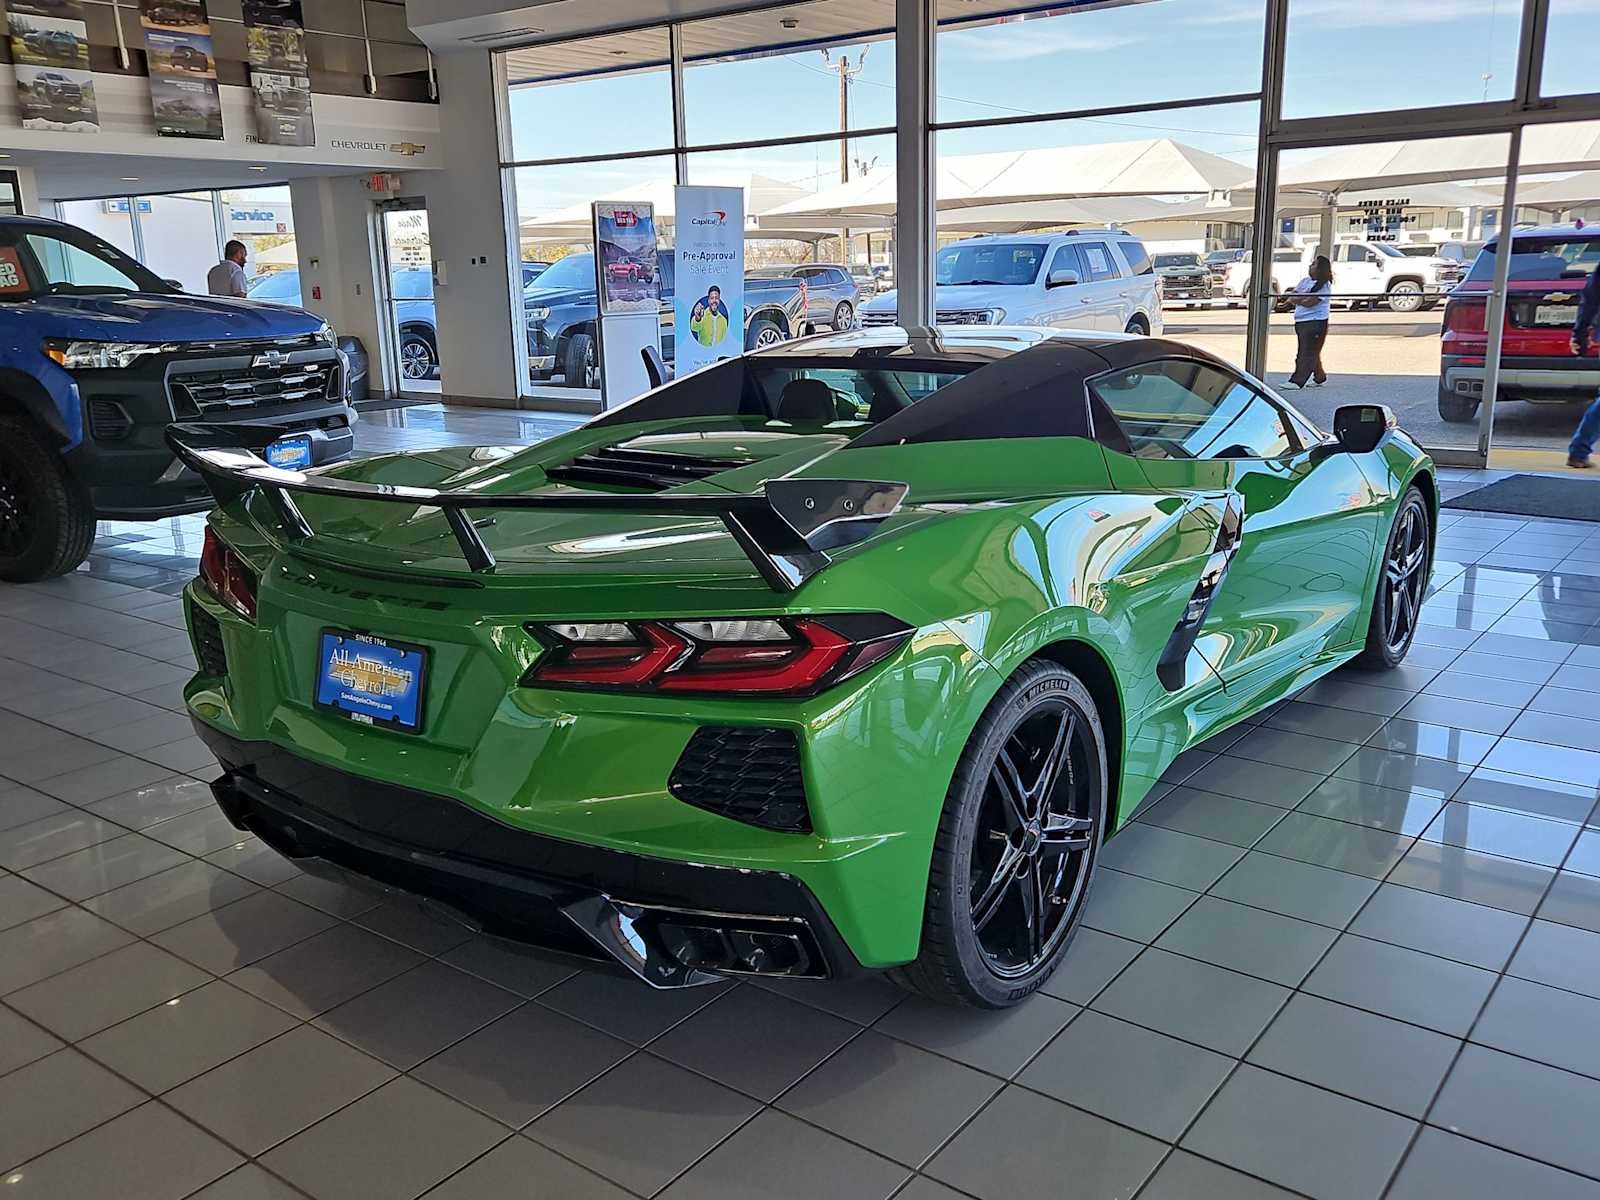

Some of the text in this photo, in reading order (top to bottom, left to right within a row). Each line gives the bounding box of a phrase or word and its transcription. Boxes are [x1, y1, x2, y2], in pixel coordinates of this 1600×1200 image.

[331, 140, 387, 151] CHEVROLET
[683, 251, 736, 262] Pre-Approval
[0, 263, 16, 275] ED
[690, 265, 728, 273] Sale Event
[0, 275, 19, 287] AG
[355, 634, 373, 645] SINCE
[330, 648, 413, 682] All American
[341, 669, 397, 698] Chevrolet
[1029, 679, 1069, 699] MICHELIN
